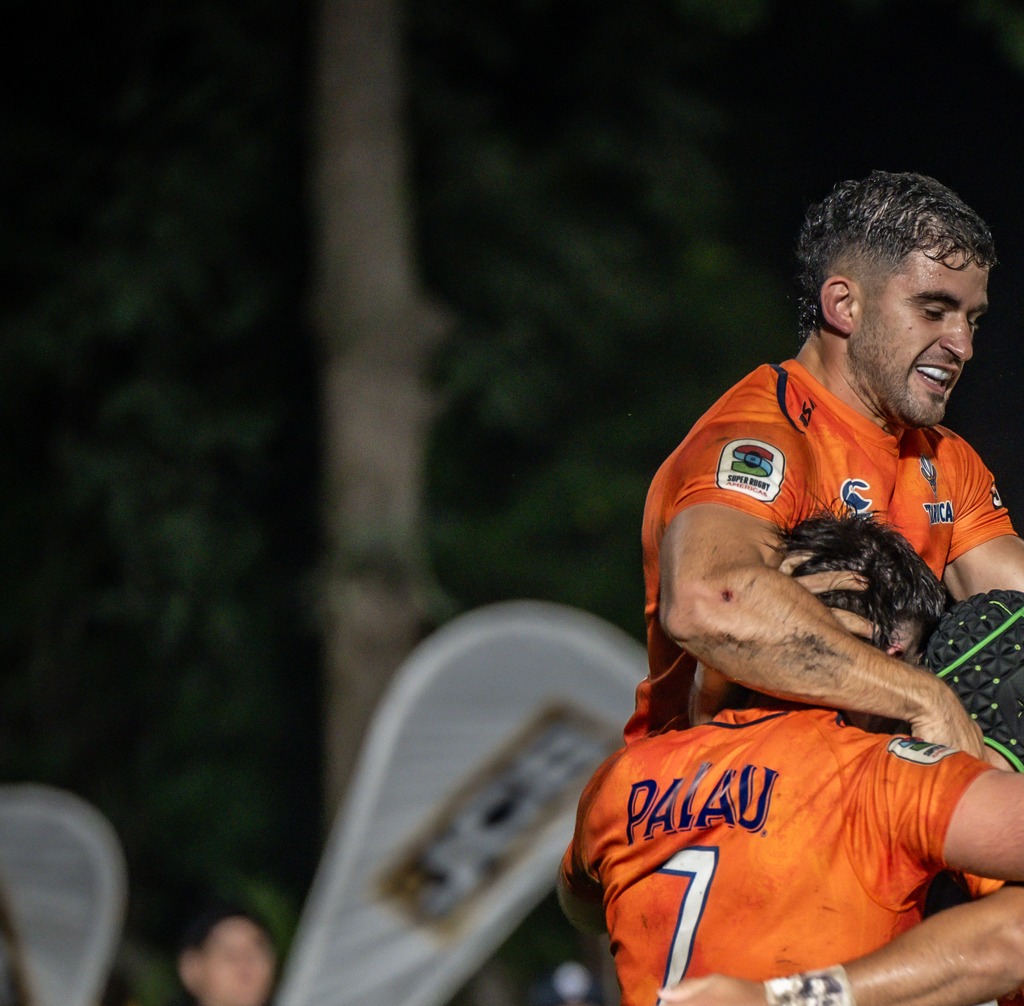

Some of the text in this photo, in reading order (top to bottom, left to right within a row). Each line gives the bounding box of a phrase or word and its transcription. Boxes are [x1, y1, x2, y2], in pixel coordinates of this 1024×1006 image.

[726, 481, 768, 497] AMERICAS
[727, 474, 770, 491] SUPER RUGBY
[626, 762, 779, 846] PALAU
[655, 846, 719, 1005] 7
